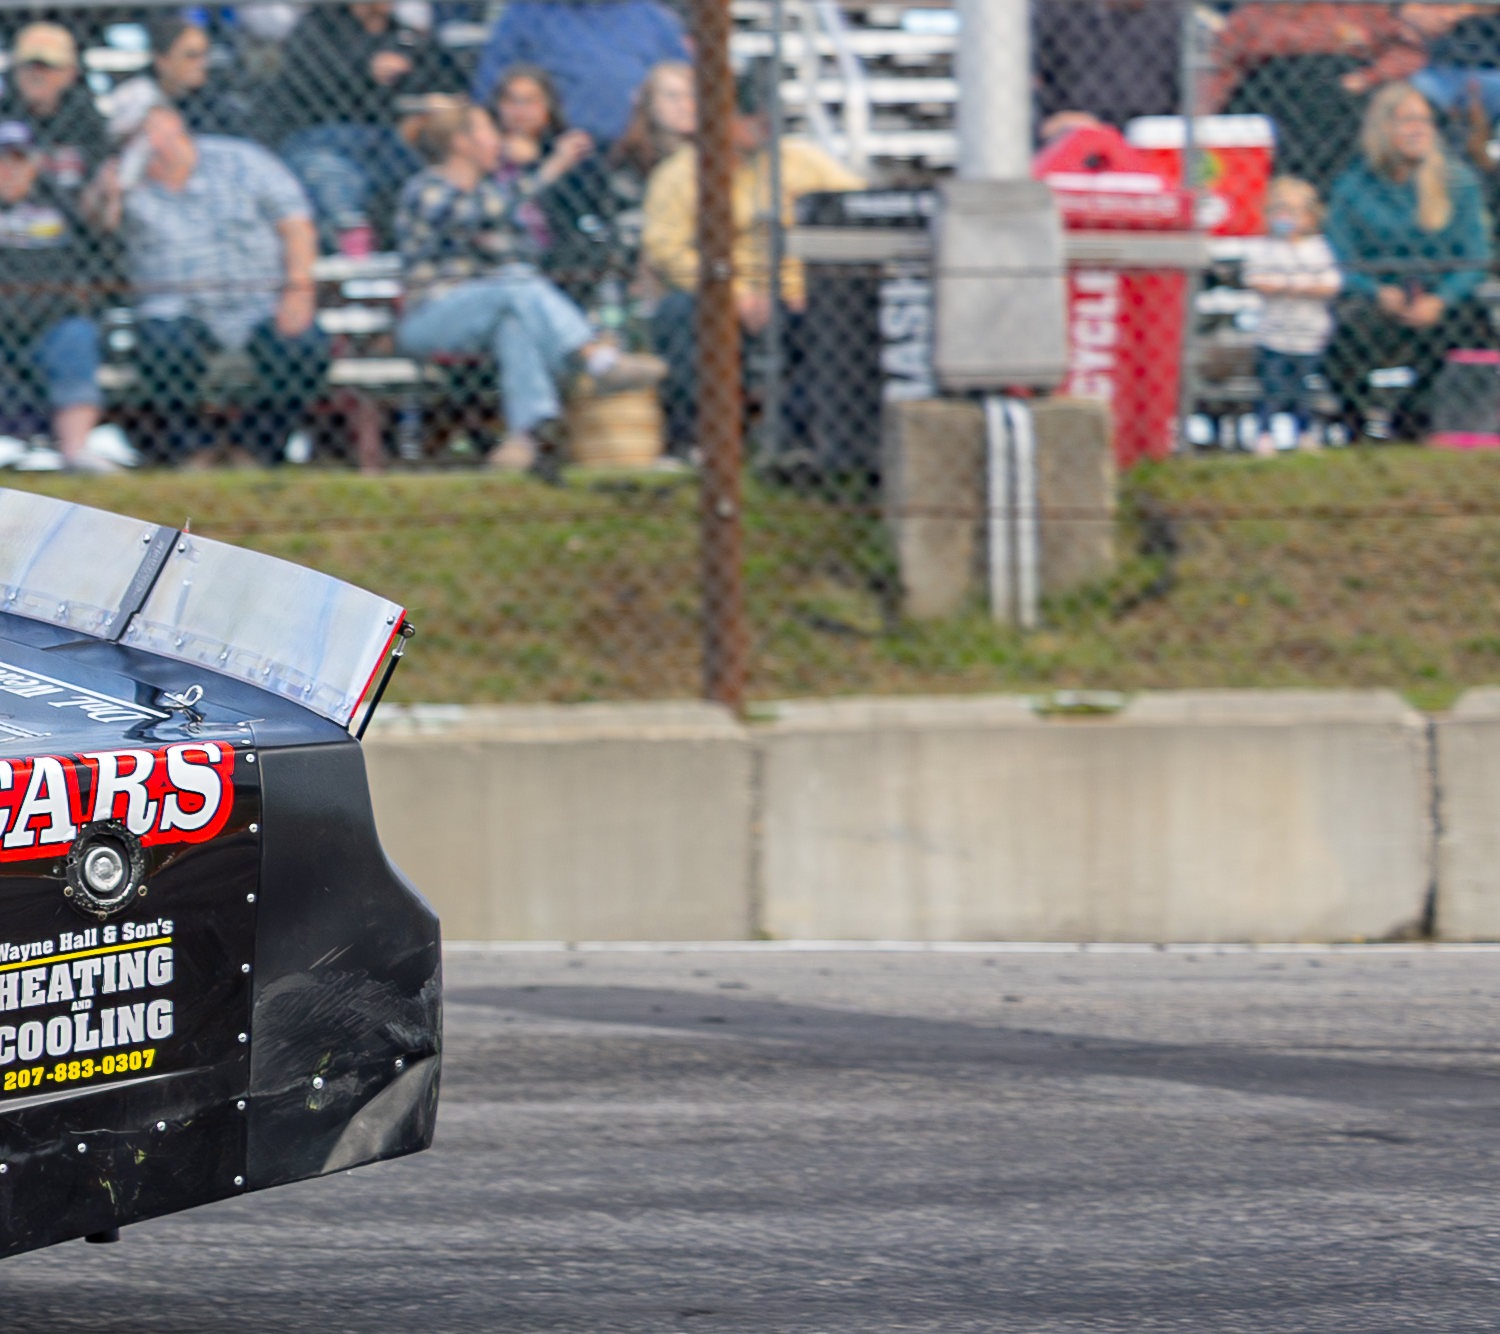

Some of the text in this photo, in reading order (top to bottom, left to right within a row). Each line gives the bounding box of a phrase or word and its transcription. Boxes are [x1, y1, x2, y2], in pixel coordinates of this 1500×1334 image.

[59, 928, 98, 951] Hall
[103, 925, 117, 944] &
[122, 918, 174, 941] Son's
[71, 999, 92, 1011] AND
[3, 1049, 156, 1091] 207-883-0307
